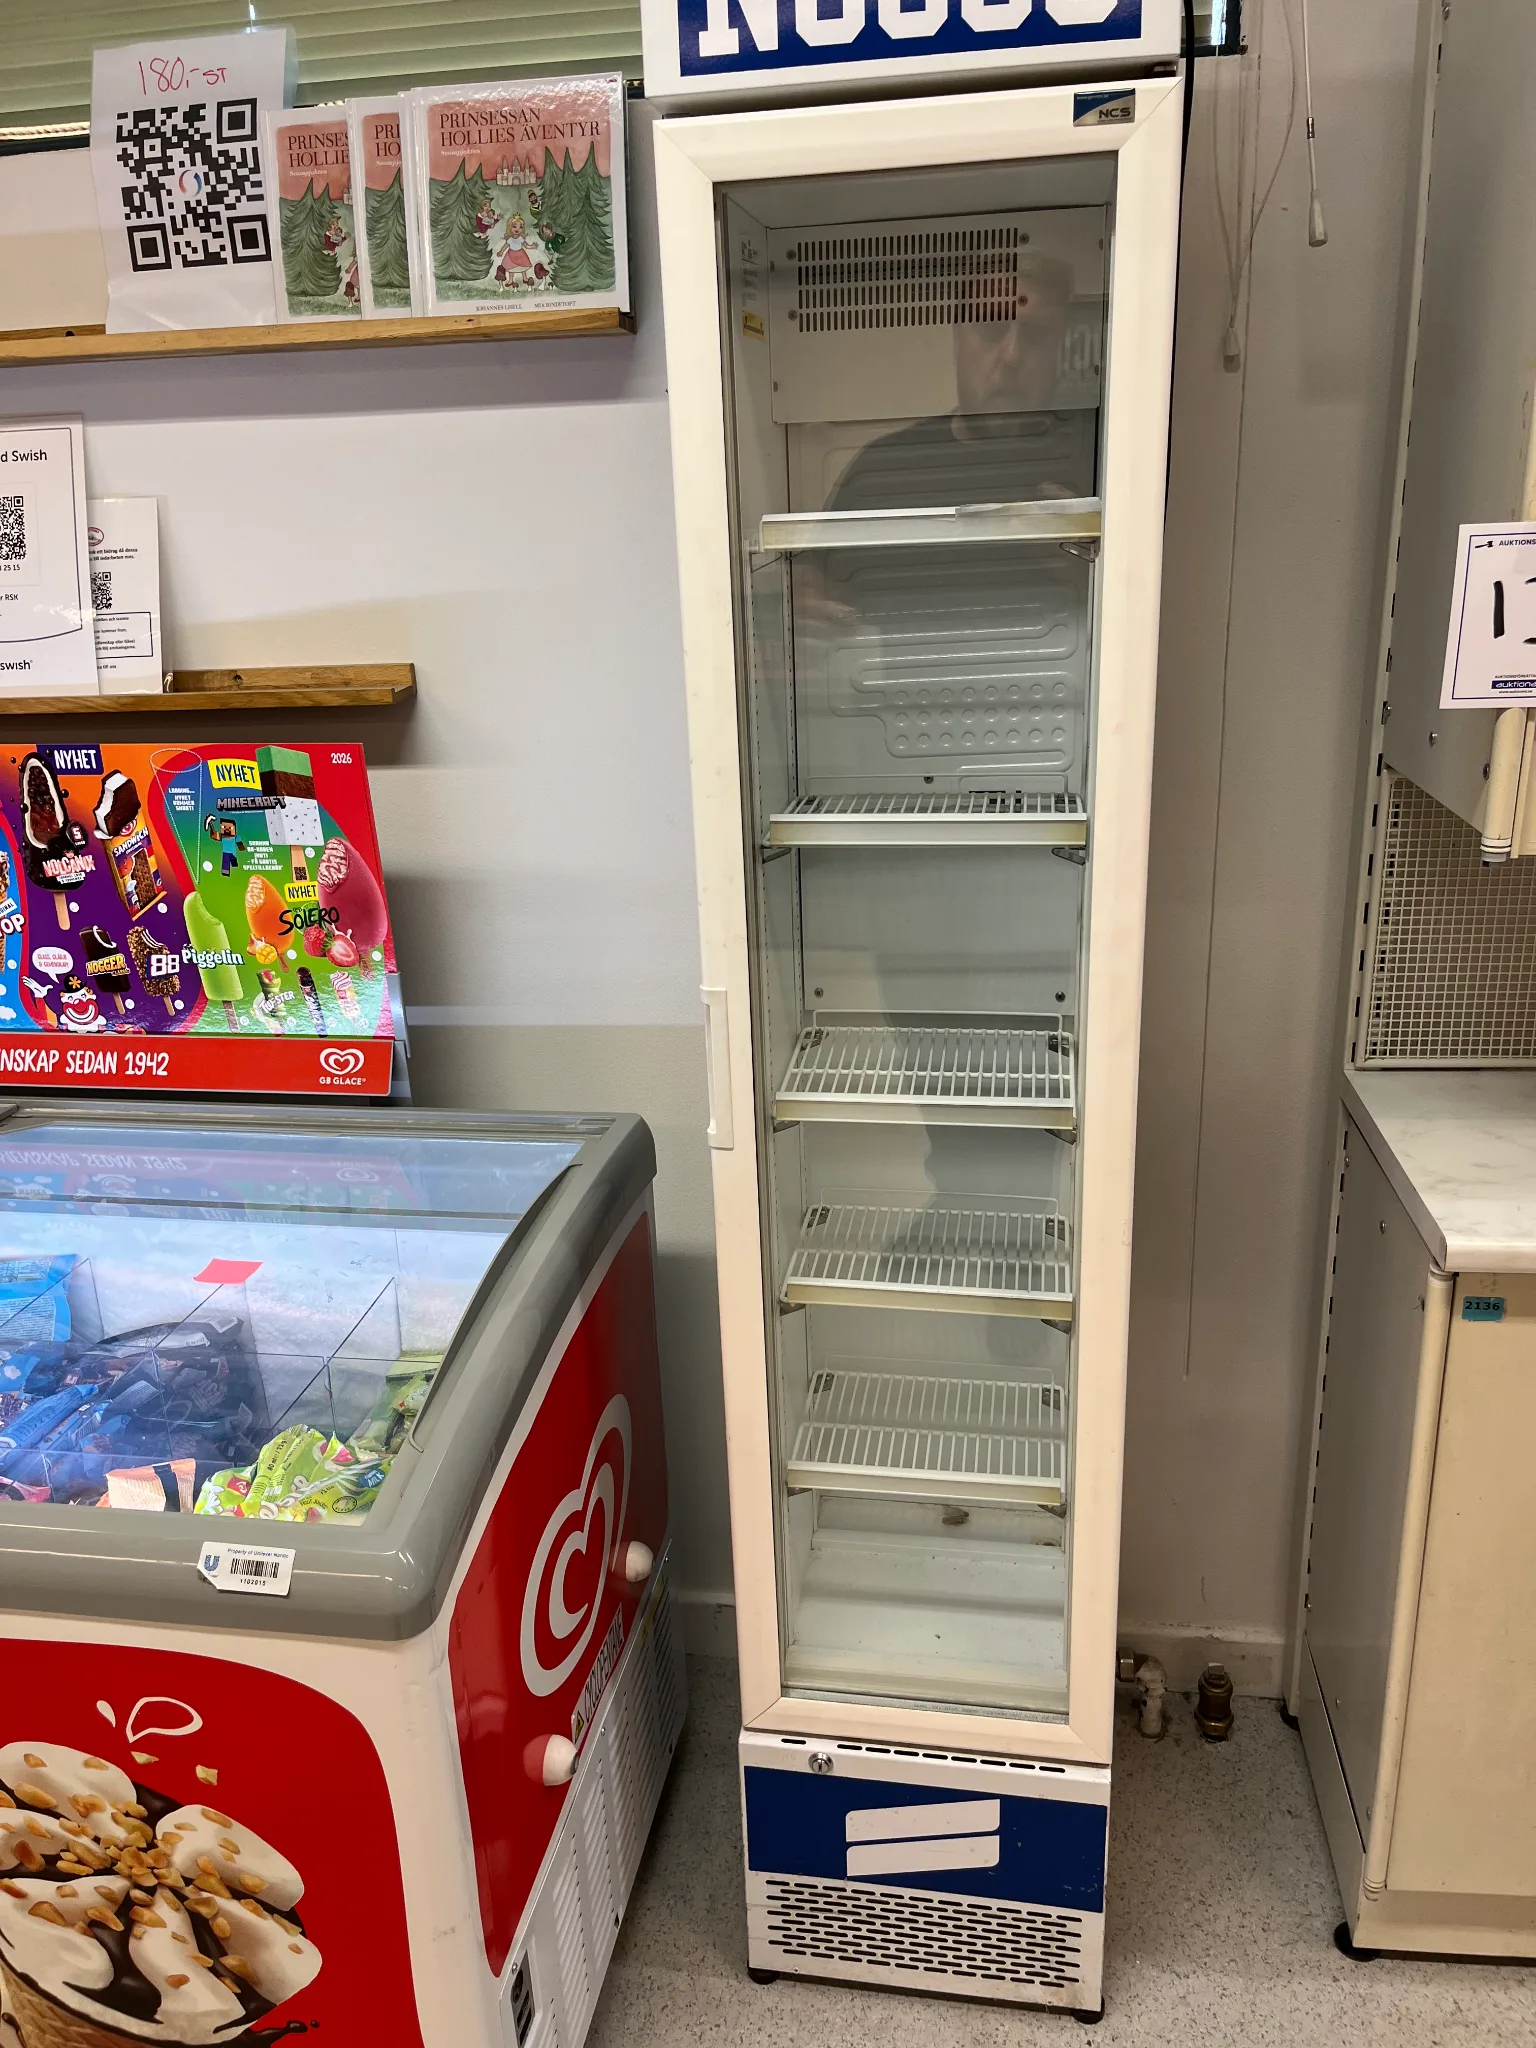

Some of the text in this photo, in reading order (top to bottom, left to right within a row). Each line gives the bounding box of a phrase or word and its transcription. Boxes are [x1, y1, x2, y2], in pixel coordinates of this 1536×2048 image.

[440, 107, 540, 129] PRINSESSAN
[1099, 107, 1130, 119] NCS
[374, 124, 400, 140] PRI
[441, 120, 601, 147] HOLLIES ÄVENTYR
[375, 141, 401, 158] HO
[11, 448, 48, 462] Swish
[5, 593, 19, 601] RSK
[53, 749, 97, 770] NYHET
[331, 752, 352, 764] 2026
[215, 763, 256, 784] NYHET
[216, 796, 287, 811] MINECRAFT
[72, 827, 82, 840] 5
[113, 826, 149, 858] SANDWICH
[287, 884, 317, 899] NYHET
[278, 906, 340, 936] SOLERO
[87, 955, 126, 975] NOGGER
[150, 954, 180, 977] 88
[181, 949, 245, 969] Piggelin
[0, 1048, 170, 1077] NSKAP SEDAN 1942
[319, 1076, 331, 1085] GB
[1464, 1300, 1501, 1311] 2136
